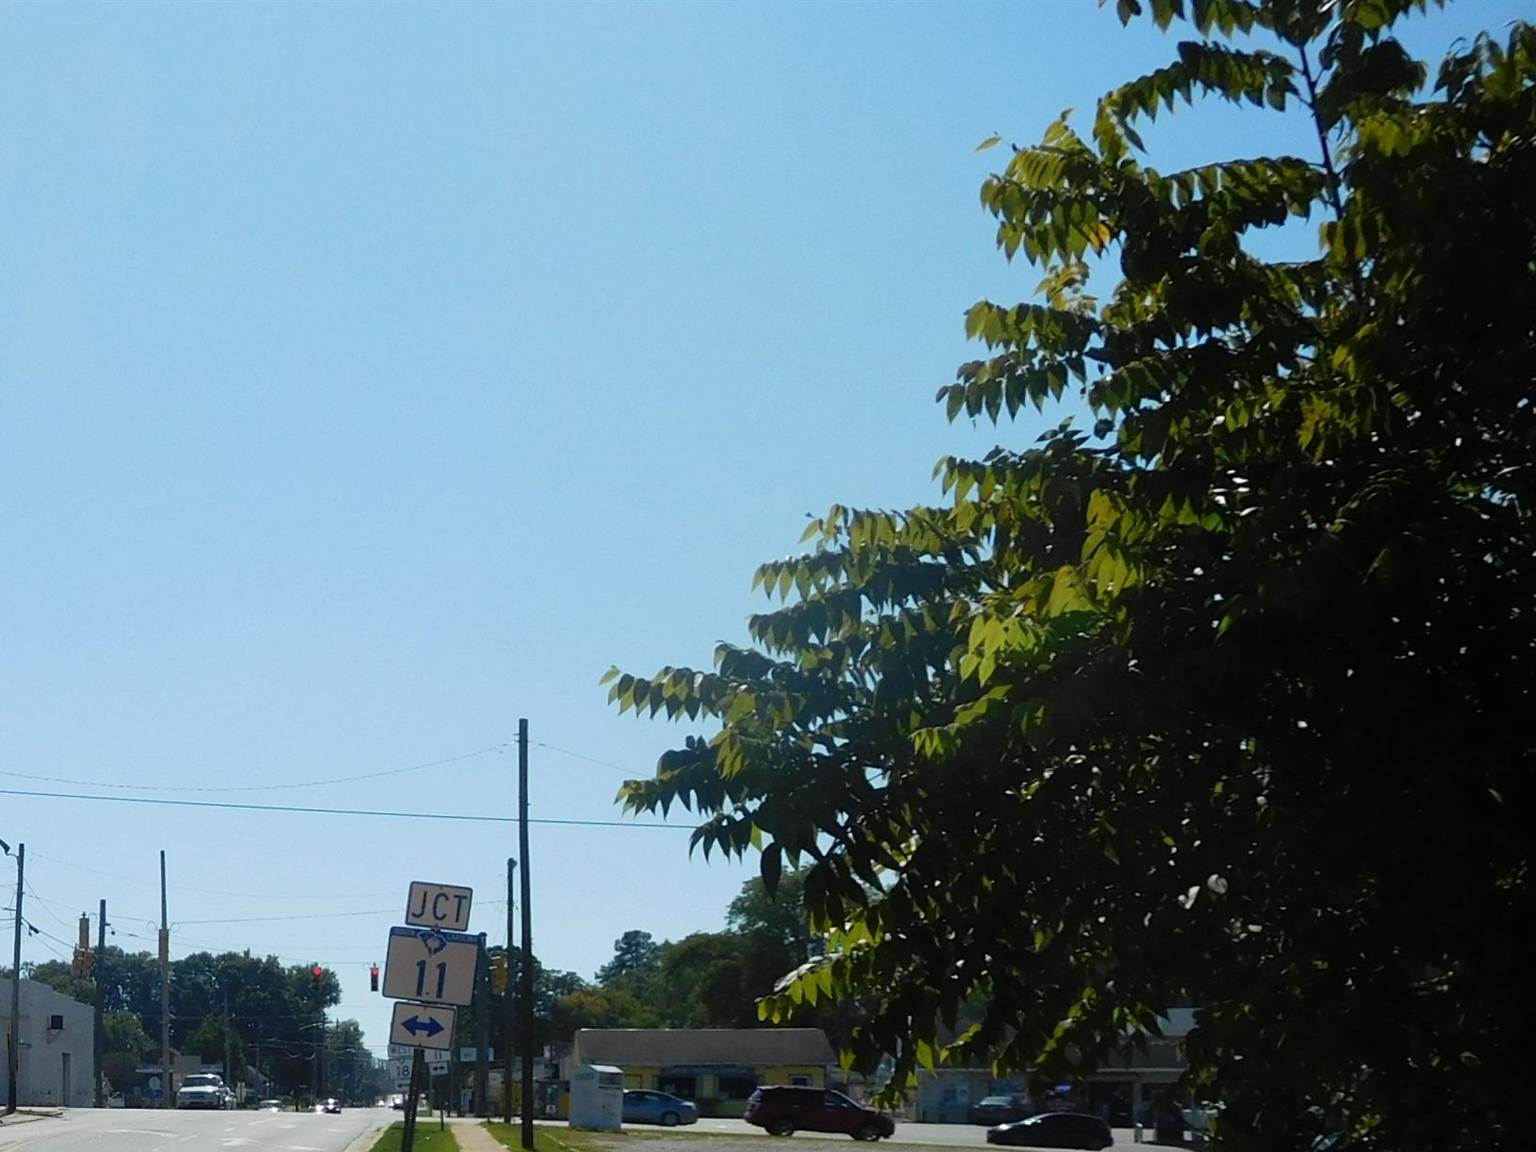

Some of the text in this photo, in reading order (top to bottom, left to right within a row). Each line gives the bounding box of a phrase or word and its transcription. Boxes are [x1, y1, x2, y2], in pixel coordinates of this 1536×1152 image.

[410, 891, 468, 923] JCT
[416, 960, 447, 999] 11
[396, 1065, 410, 1077] 18
